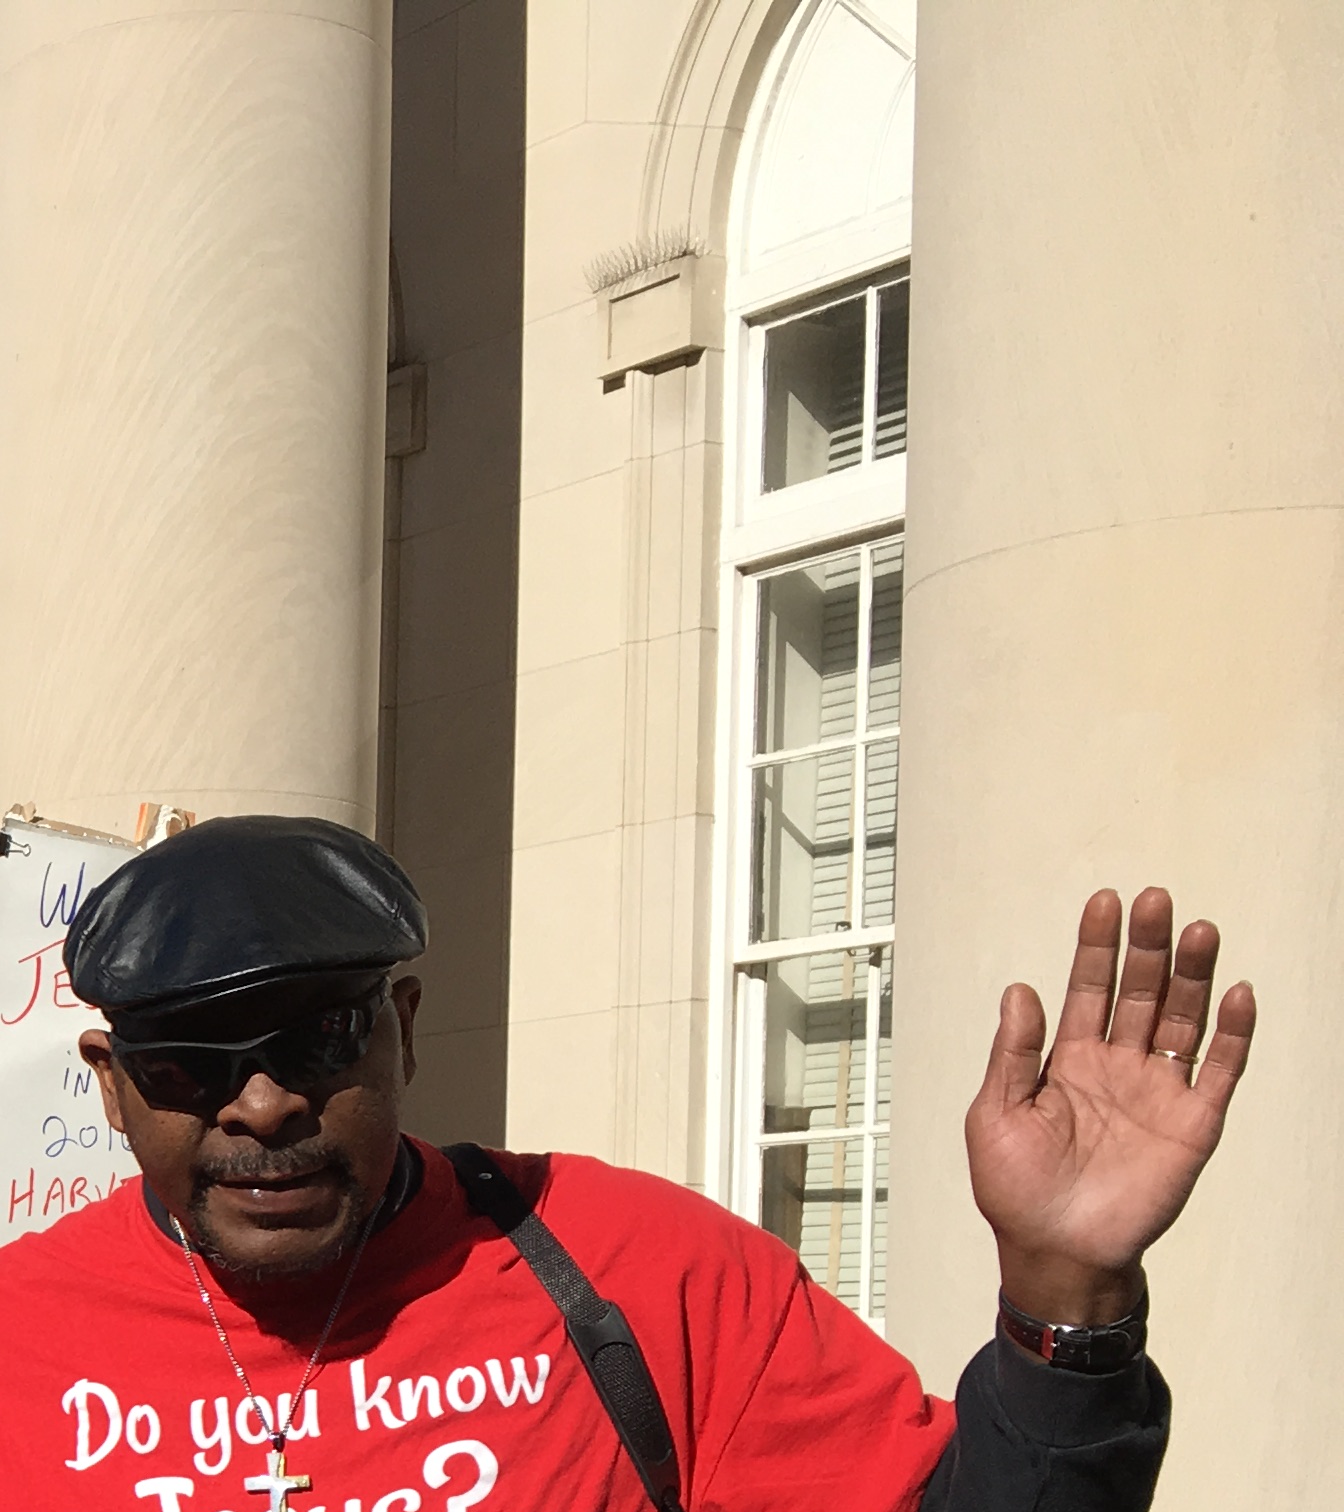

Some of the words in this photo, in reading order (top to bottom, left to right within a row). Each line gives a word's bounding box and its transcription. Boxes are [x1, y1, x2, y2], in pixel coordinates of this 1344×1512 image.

[61, 1378, 162, 1471] Do
[190, 1387, 322, 1476] you
[349, 1353, 551, 1432] know
